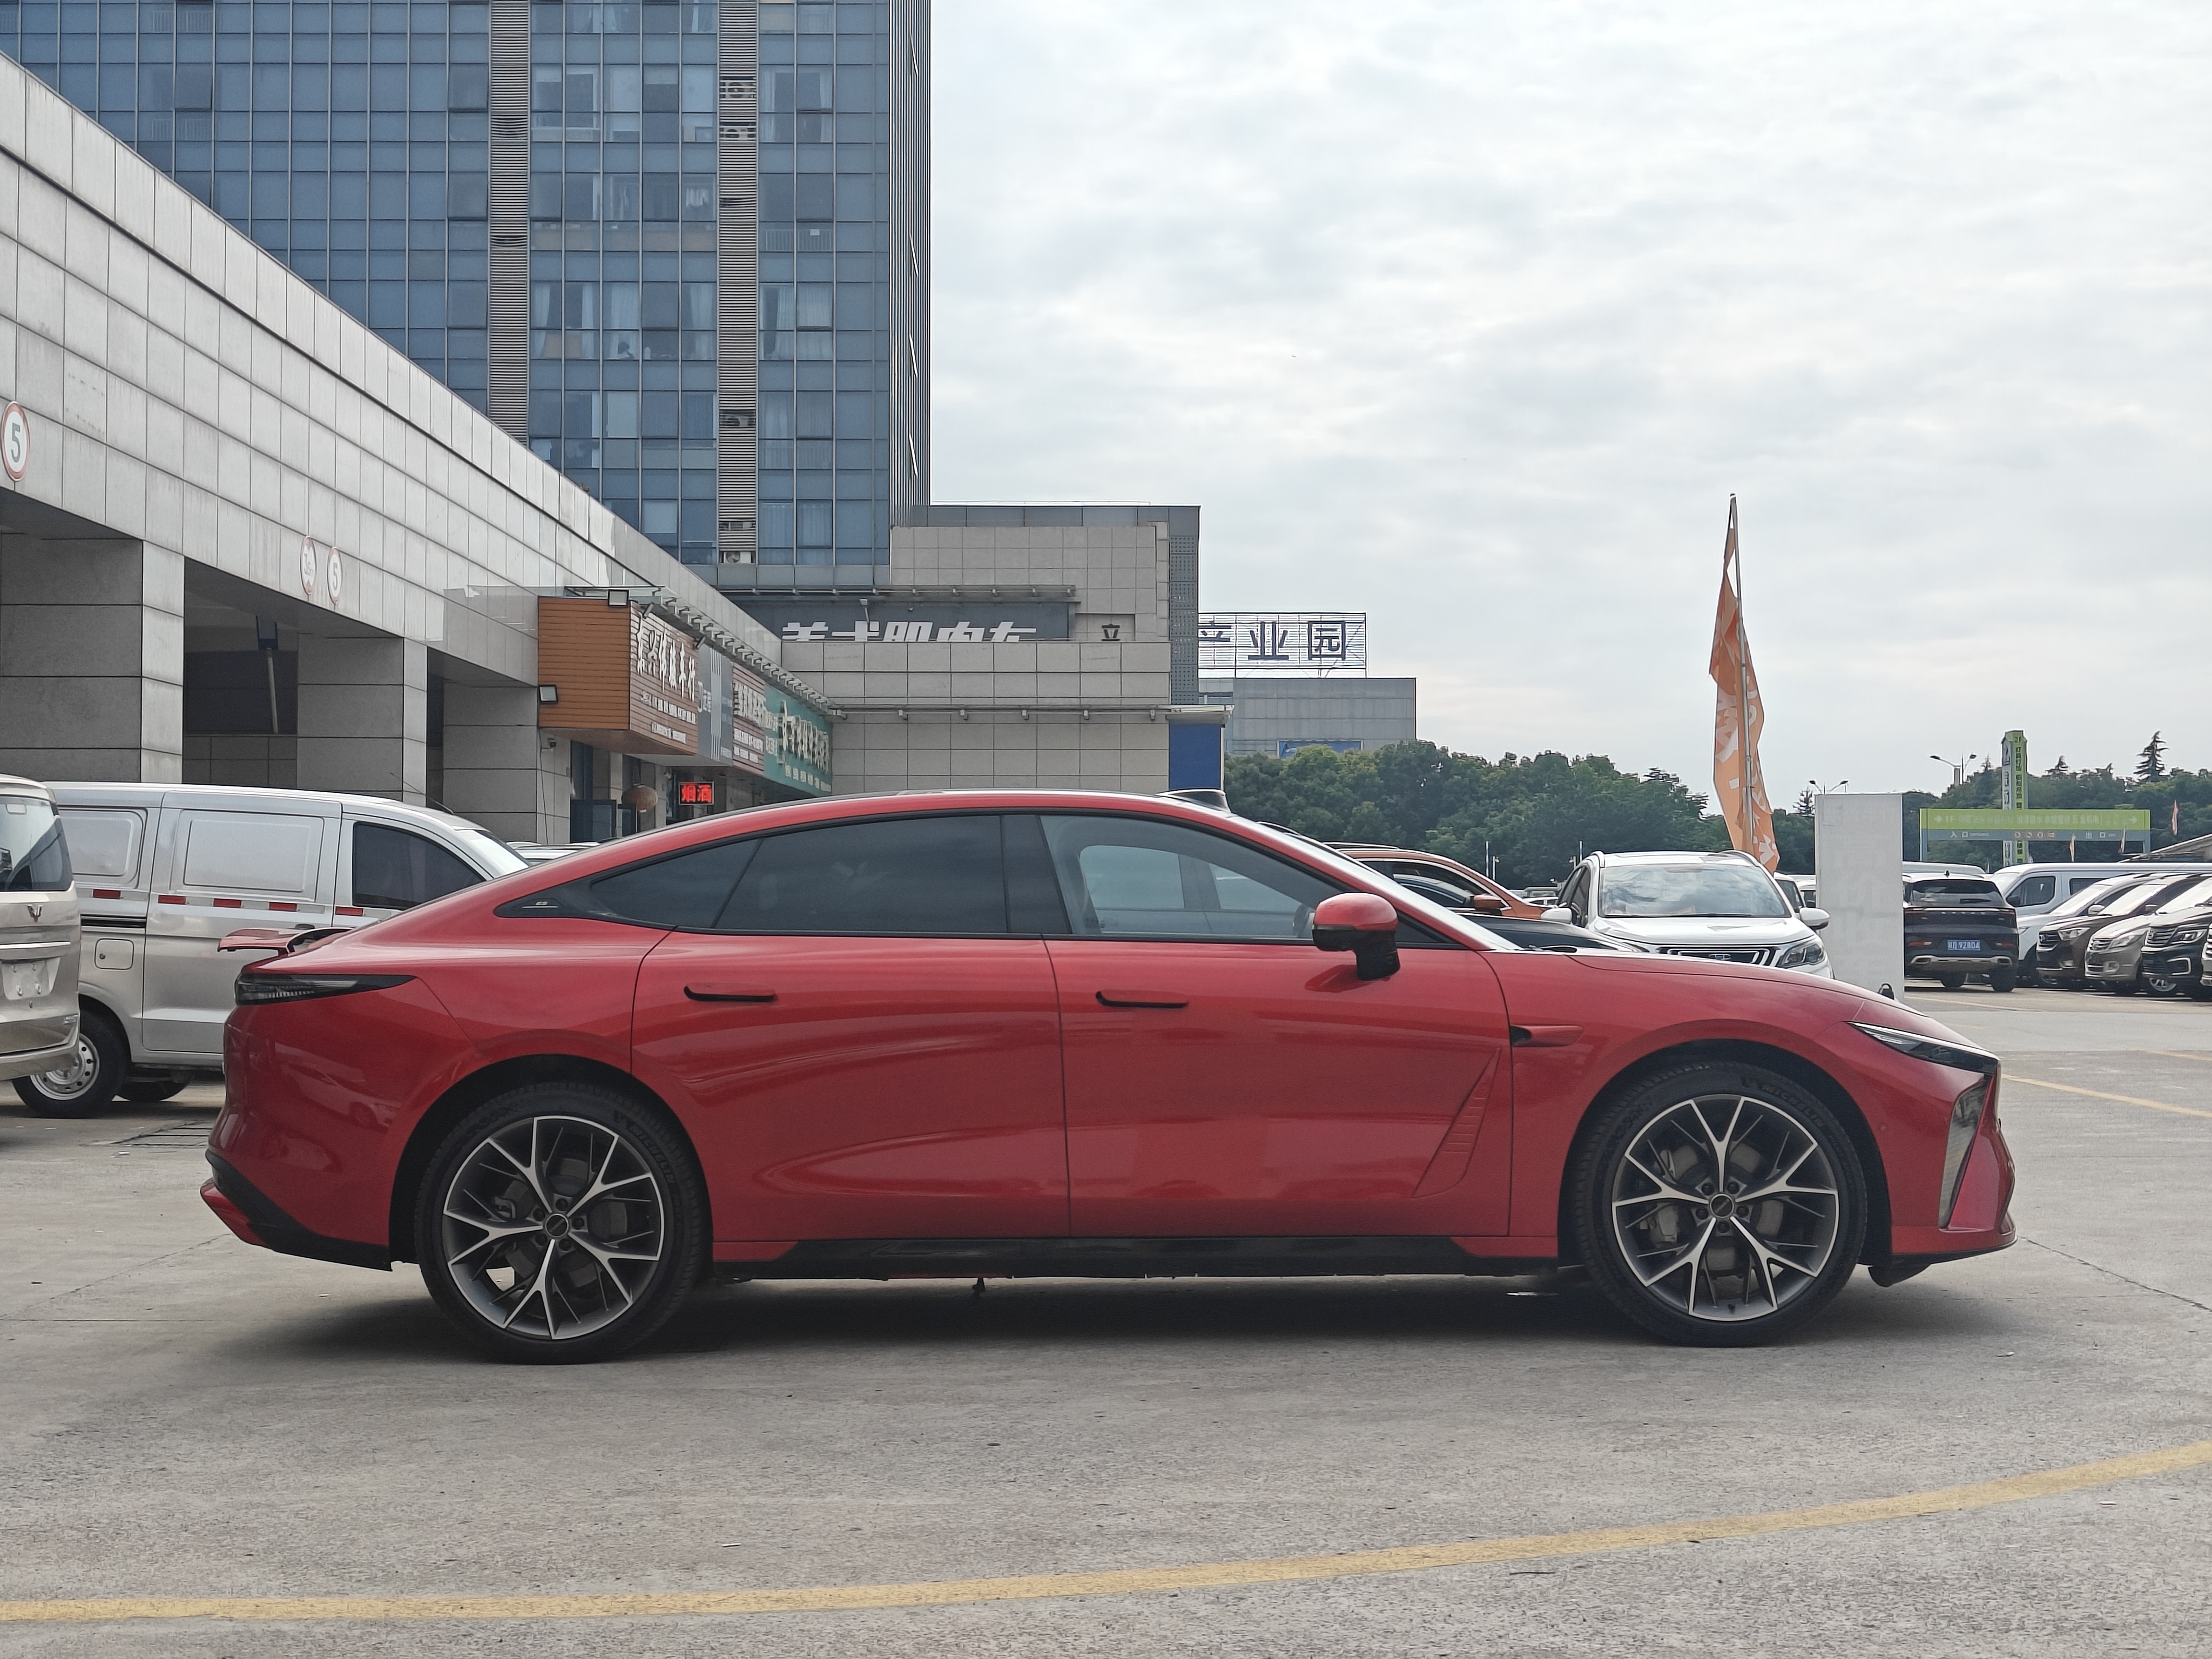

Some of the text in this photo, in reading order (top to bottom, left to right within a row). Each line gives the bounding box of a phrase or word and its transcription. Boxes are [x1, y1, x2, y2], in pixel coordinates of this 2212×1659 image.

[11, 422, 21, 463] 5
[333, 563, 338, 591] 5
[1762, 1083, 1825, 1129] MICHELIN
[629, 1125, 676, 1184] MICHELIN
